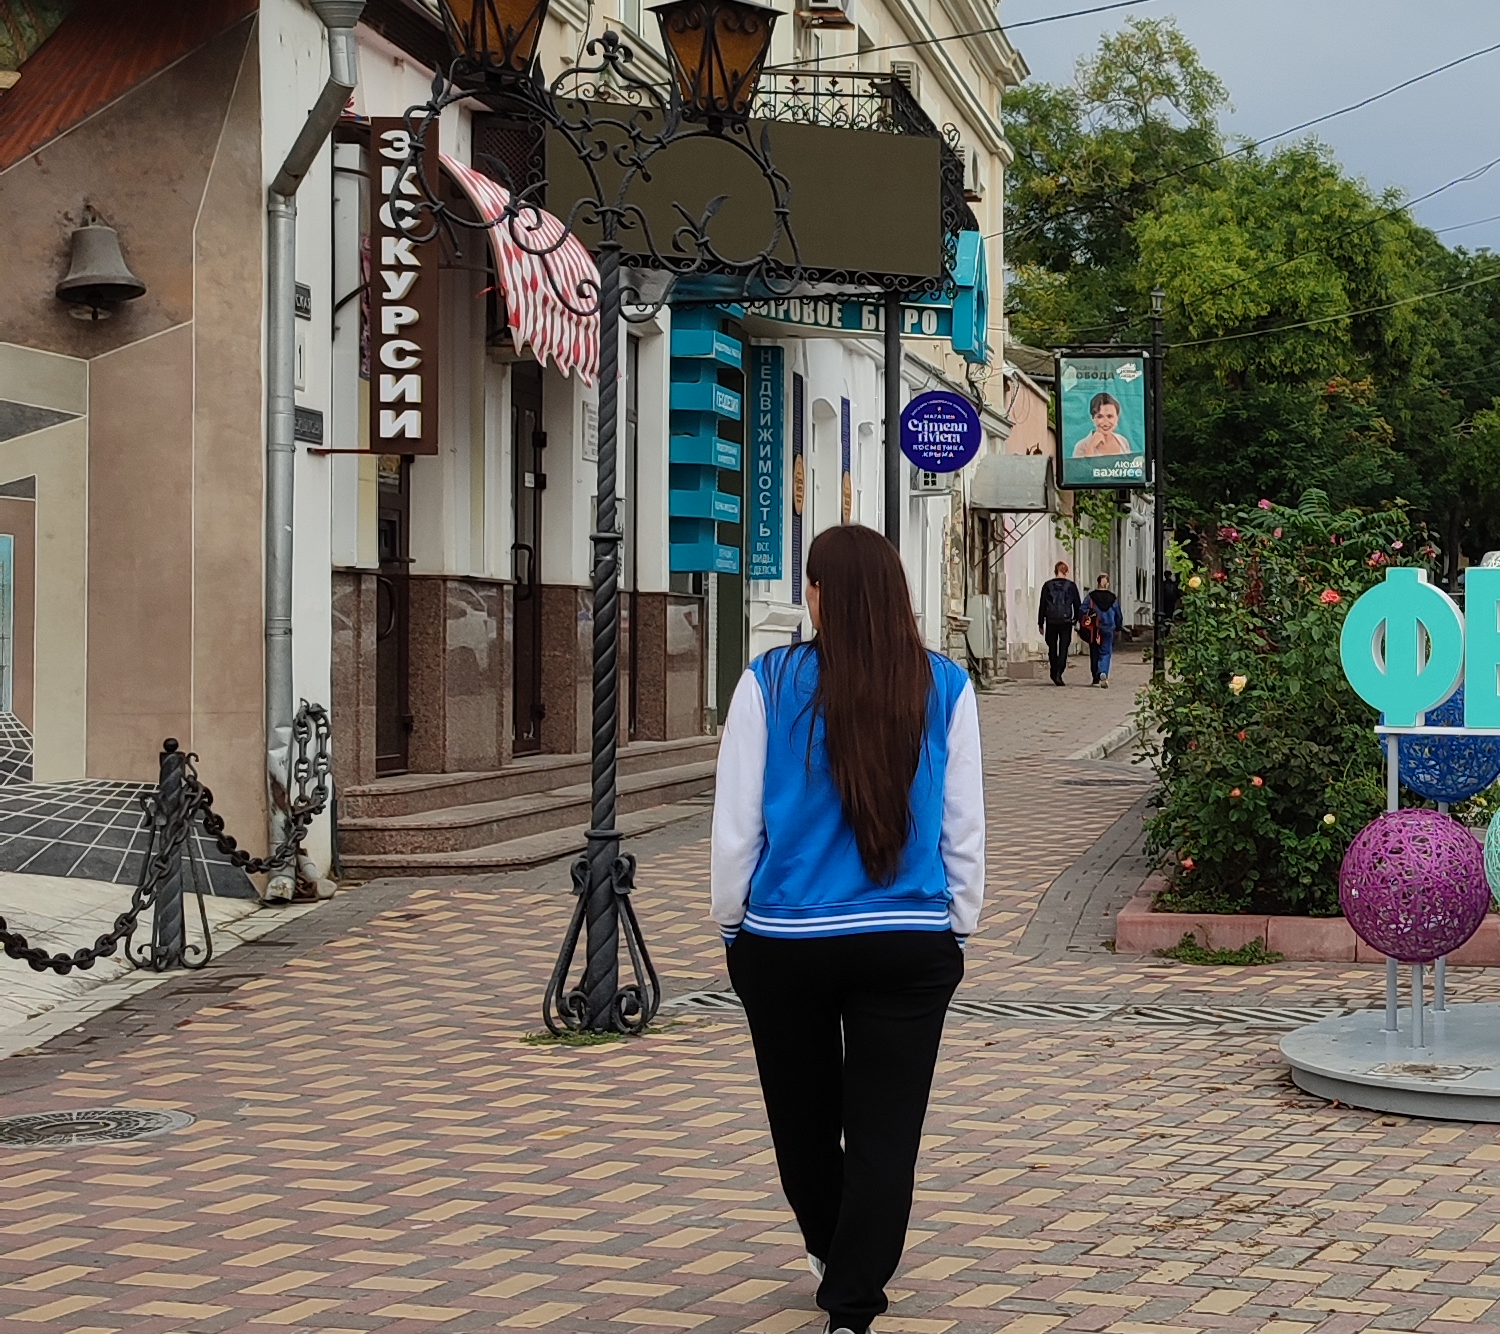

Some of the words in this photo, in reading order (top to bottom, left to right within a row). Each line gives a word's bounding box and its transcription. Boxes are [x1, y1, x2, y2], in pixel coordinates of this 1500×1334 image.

[379, 129, 423, 439] ЭКСКУРСИИ
[861, 305, 938, 335] БРО
[757, 349, 774, 537] НЕДВИЖИМОСТЬ
[912, 444, 965, 452] КОСМЕТИКА
[918, 431, 961, 444] riviera
